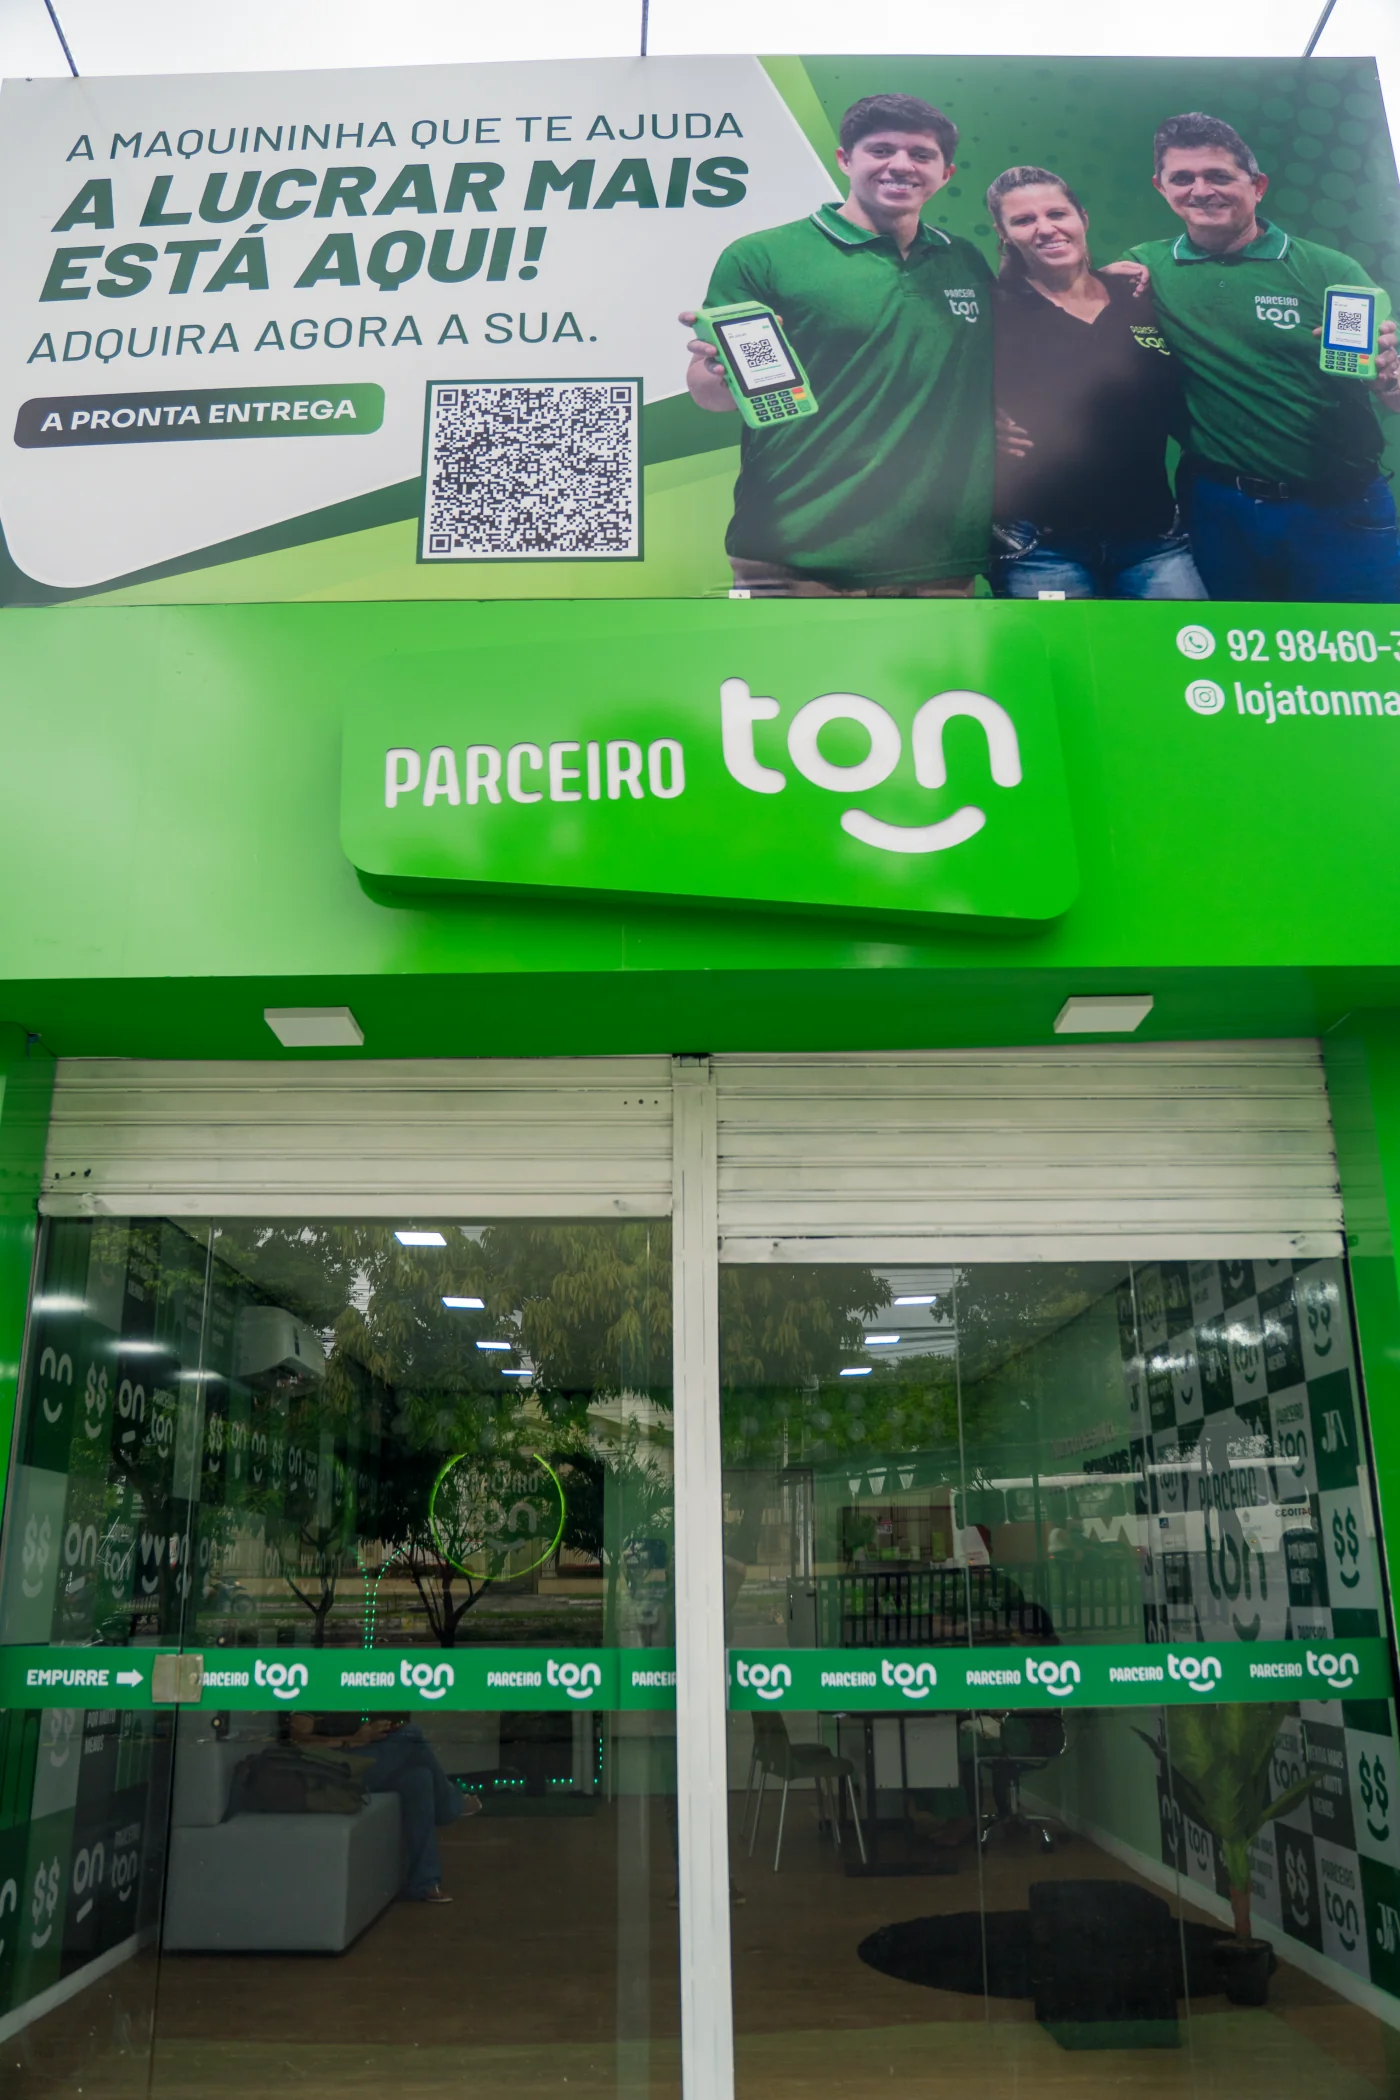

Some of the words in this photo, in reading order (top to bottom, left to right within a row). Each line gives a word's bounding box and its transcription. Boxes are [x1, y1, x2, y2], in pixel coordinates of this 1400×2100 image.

[66, 134, 95, 162] A
[110, 122, 397, 160] MAQUININHA
[411, 117, 502, 150] QUE
[515, 115, 573, 143] TE
[585, 112, 744, 141] AJUDA
[51, 178, 115, 233] A
[139, 161, 506, 228] LUCRAR
[523, 155, 749, 211] MAIS
[39, 223, 270, 303] ESTÁ
[294, 226, 548, 292] AQUI!
[948, 299, 980, 315] ton
[1254, 295, 1298, 307] PARCEIRO
[1256, 305, 1300, 324] ton
[26, 322, 240, 364] ADQUIRA
[253, 315, 423, 352] AGORA
[437, 313, 469, 346] A
[484, 311, 598, 345] SUA.
[40, 412, 63, 432] A
[70, 405, 201, 430] PRONTA
[208, 399, 357, 424] ENTREGA
[1227, 629, 1270, 662] 92
[1234, 681, 1400, 724] lojatonma
[384, 738, 686, 809] PARCEIRO
[719, 677, 1023, 795] ton
[1198, 1466, 1258, 1511] PARCEIRO
[26, 1668, 110, 1687] EMPURRE
[200, 1671, 249, 1687] ARCEIRO
[254, 1659, 309, 1687] ton
[340, 1671, 395, 1688] PARCEIRO
[400, 1659, 455, 1687] ton
[487, 1671, 542, 1688] PARCEIRO
[546, 1659, 602, 1687] ton
[736, 1660, 792, 1688] ton
[821, 1671, 877, 1688] PARCEIRO
[881, 1659, 938, 1687] ton
[966, 1669, 1022, 1686] PARCEIRO
[1025, 1657, 1081, 1685] ton
[1109, 1665, 1165, 1683] PARCEIRO
[1167, 1653, 1222, 1681] ton
[1249, 1662, 1303, 1679] PARCEIRO
[1306, 1650, 1360, 1677] ton
